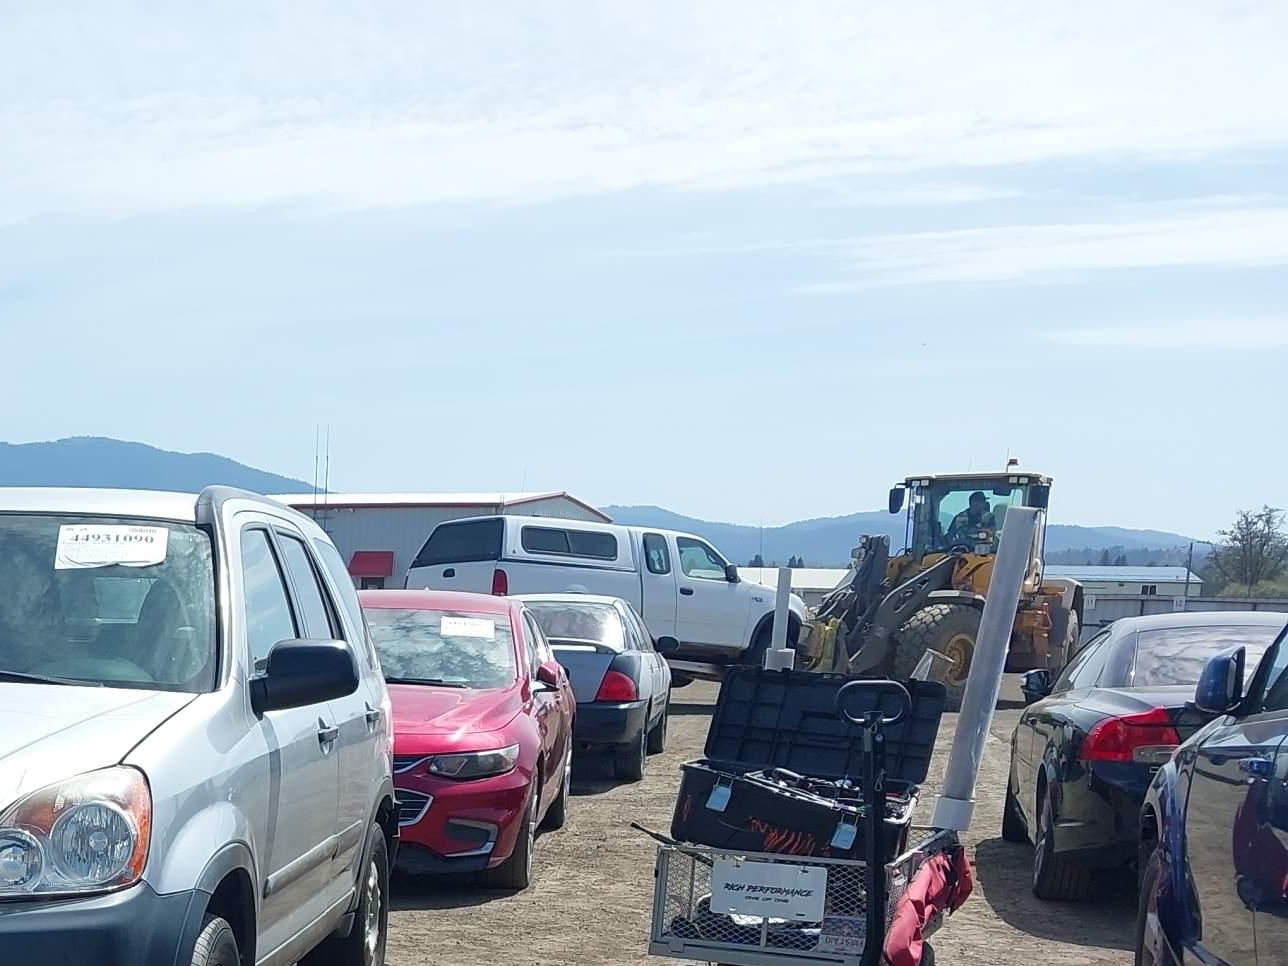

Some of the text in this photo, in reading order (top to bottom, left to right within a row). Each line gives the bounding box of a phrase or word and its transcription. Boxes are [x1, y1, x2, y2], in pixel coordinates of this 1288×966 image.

[70, 533, 155, 544] 44931090
[723, 882, 814, 898] RICH PERFORMANCE
